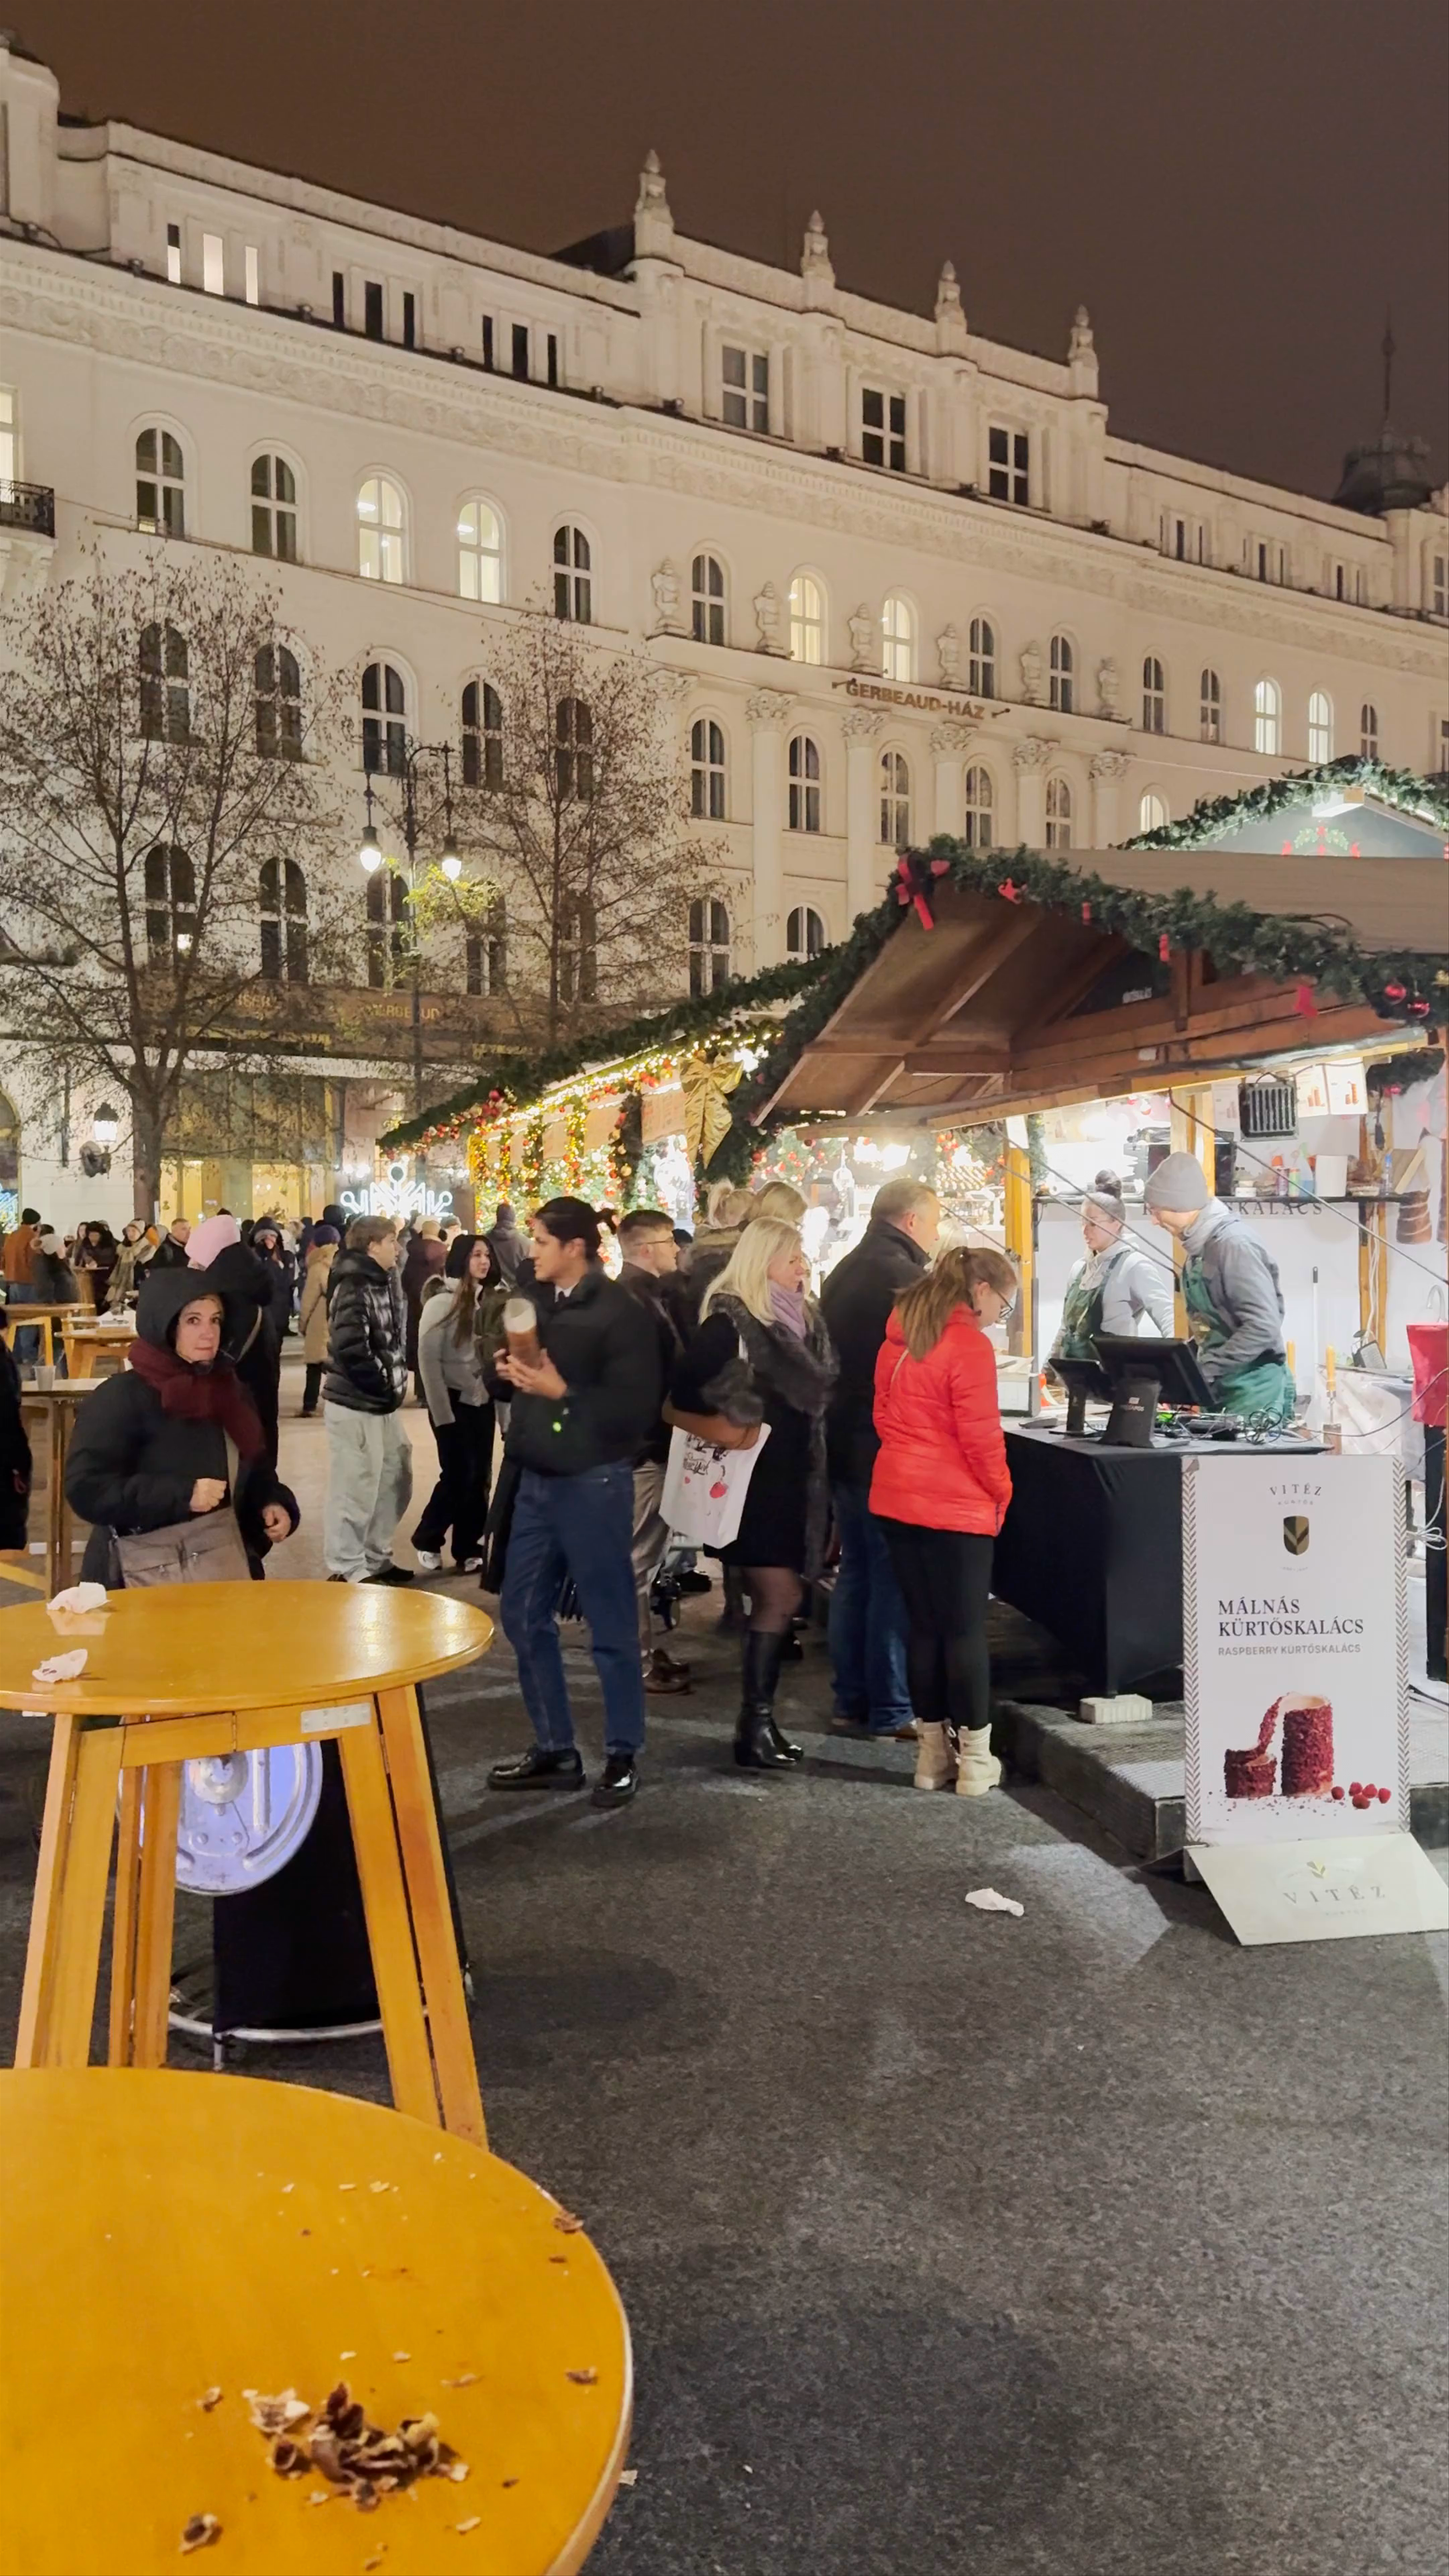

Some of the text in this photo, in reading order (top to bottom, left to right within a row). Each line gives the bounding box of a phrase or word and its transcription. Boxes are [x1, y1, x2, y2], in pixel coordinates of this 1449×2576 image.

[845, 681, 987, 720] GERBEAUD-HÁZ
[1269, 1483, 1322, 1496] VITÉZ
[1218, 1596, 1300, 1615] MÁLNÁS
[1219, 1616, 1364, 1636] KÜRTŐSKALÁCS
[1218, 1646, 1278, 1656] RASPBERRY
[1283, 1885, 1385, 1904] VITÉZ
